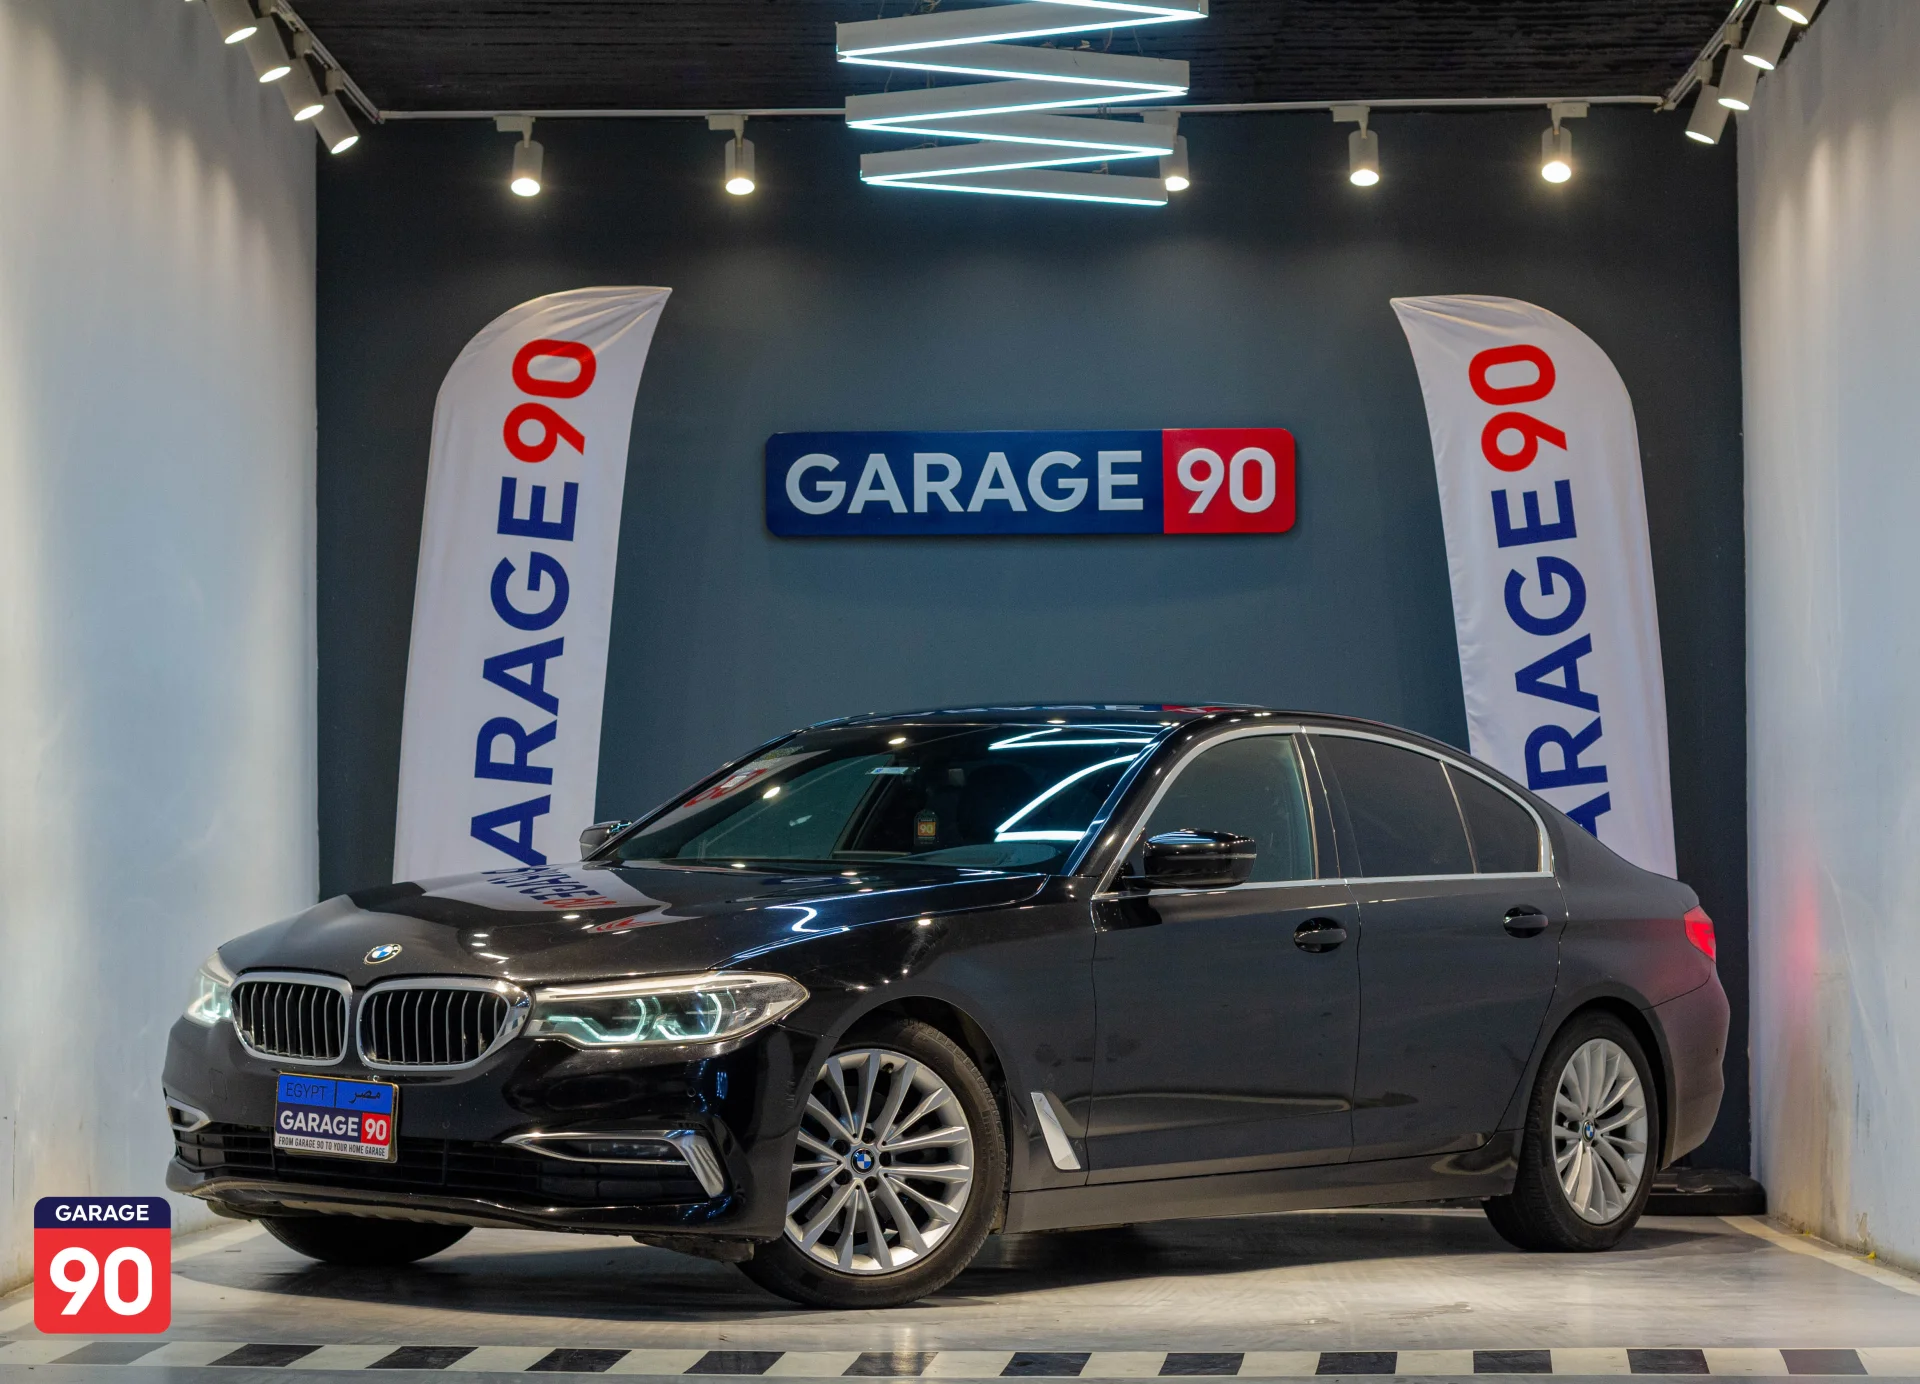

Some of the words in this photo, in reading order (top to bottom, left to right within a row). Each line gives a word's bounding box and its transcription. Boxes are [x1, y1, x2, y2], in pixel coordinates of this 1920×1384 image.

[785, 450, 1144, 515] GARAGE
[1177, 446, 1277, 514] 90
[285, 1082, 328, 1101] EGYPT
[348, 1089, 381, 1104] مصر
[280, 1110, 359, 1137] GARAGE
[364, 1118, 387, 1141] 90
[278, 1136, 294, 1147] FROM
[295, 1138, 316, 1149] GARAGE
[316, 1141, 324, 1150] 90
[325, 1141, 333, 1151] TO
[333, 1142, 348, 1152] YOUR
[349, 1144, 364, 1154] HOME
[365, 1146, 386, 1157] GARAGE
